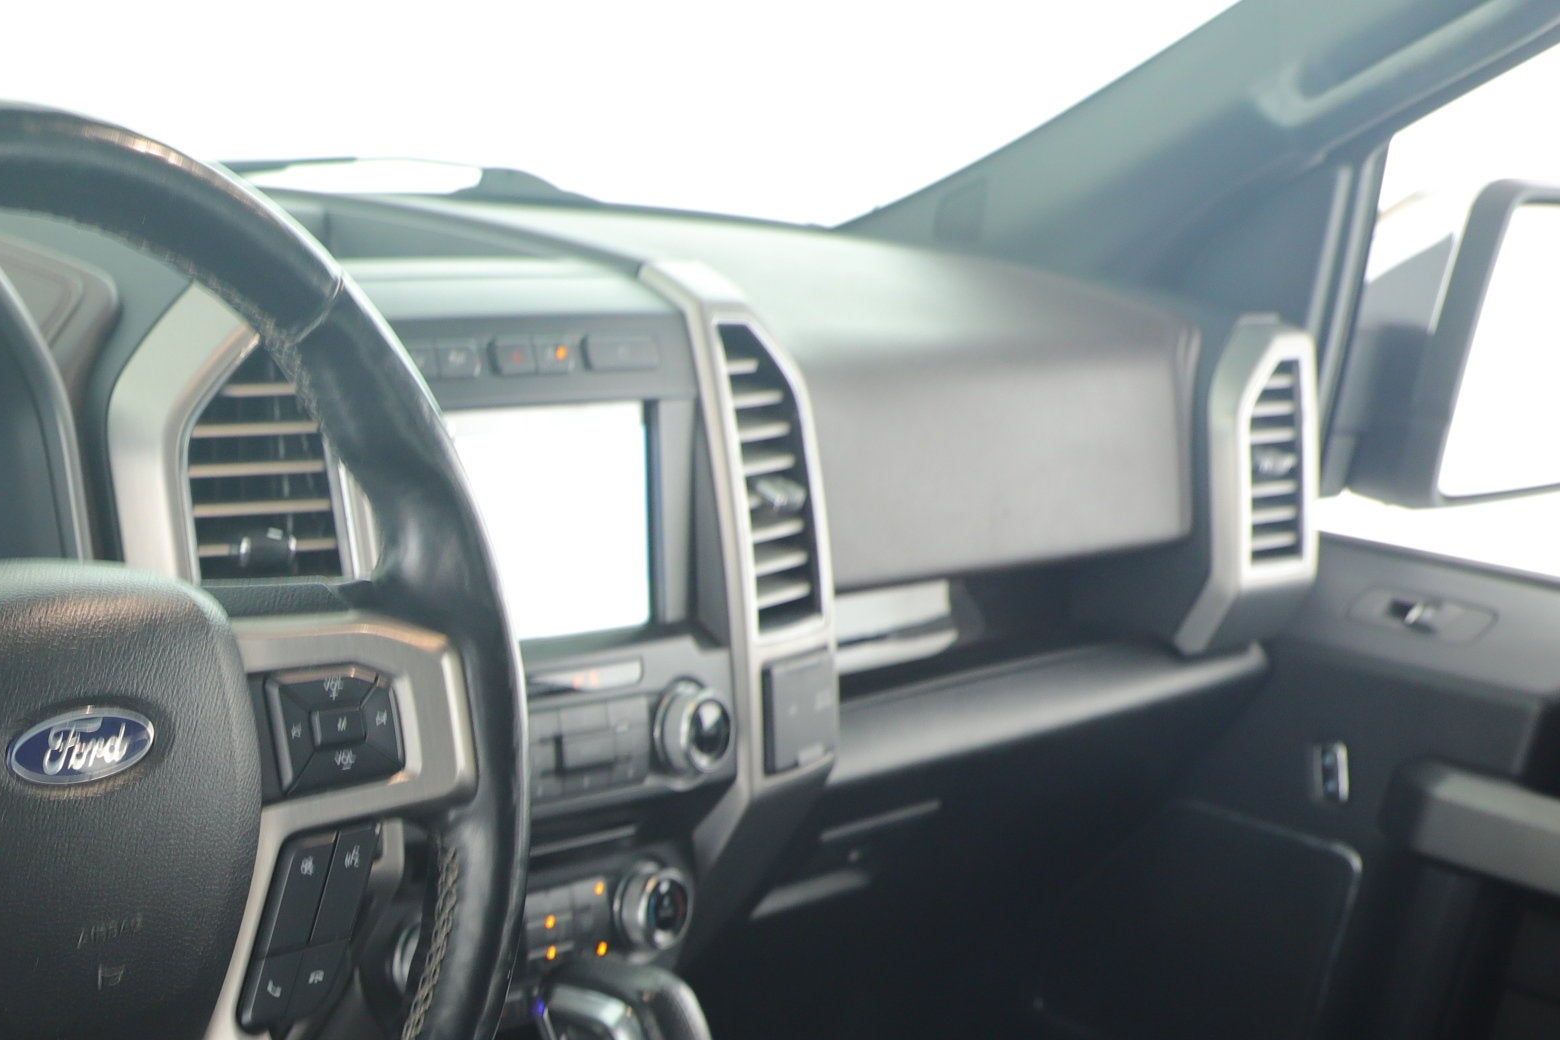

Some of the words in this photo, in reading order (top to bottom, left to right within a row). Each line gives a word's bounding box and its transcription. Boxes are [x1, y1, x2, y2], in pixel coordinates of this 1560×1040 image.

[323, 676, 344, 692] VOL
[43, 716, 132, 776] Ford
[334, 749, 356, 766] VOL
